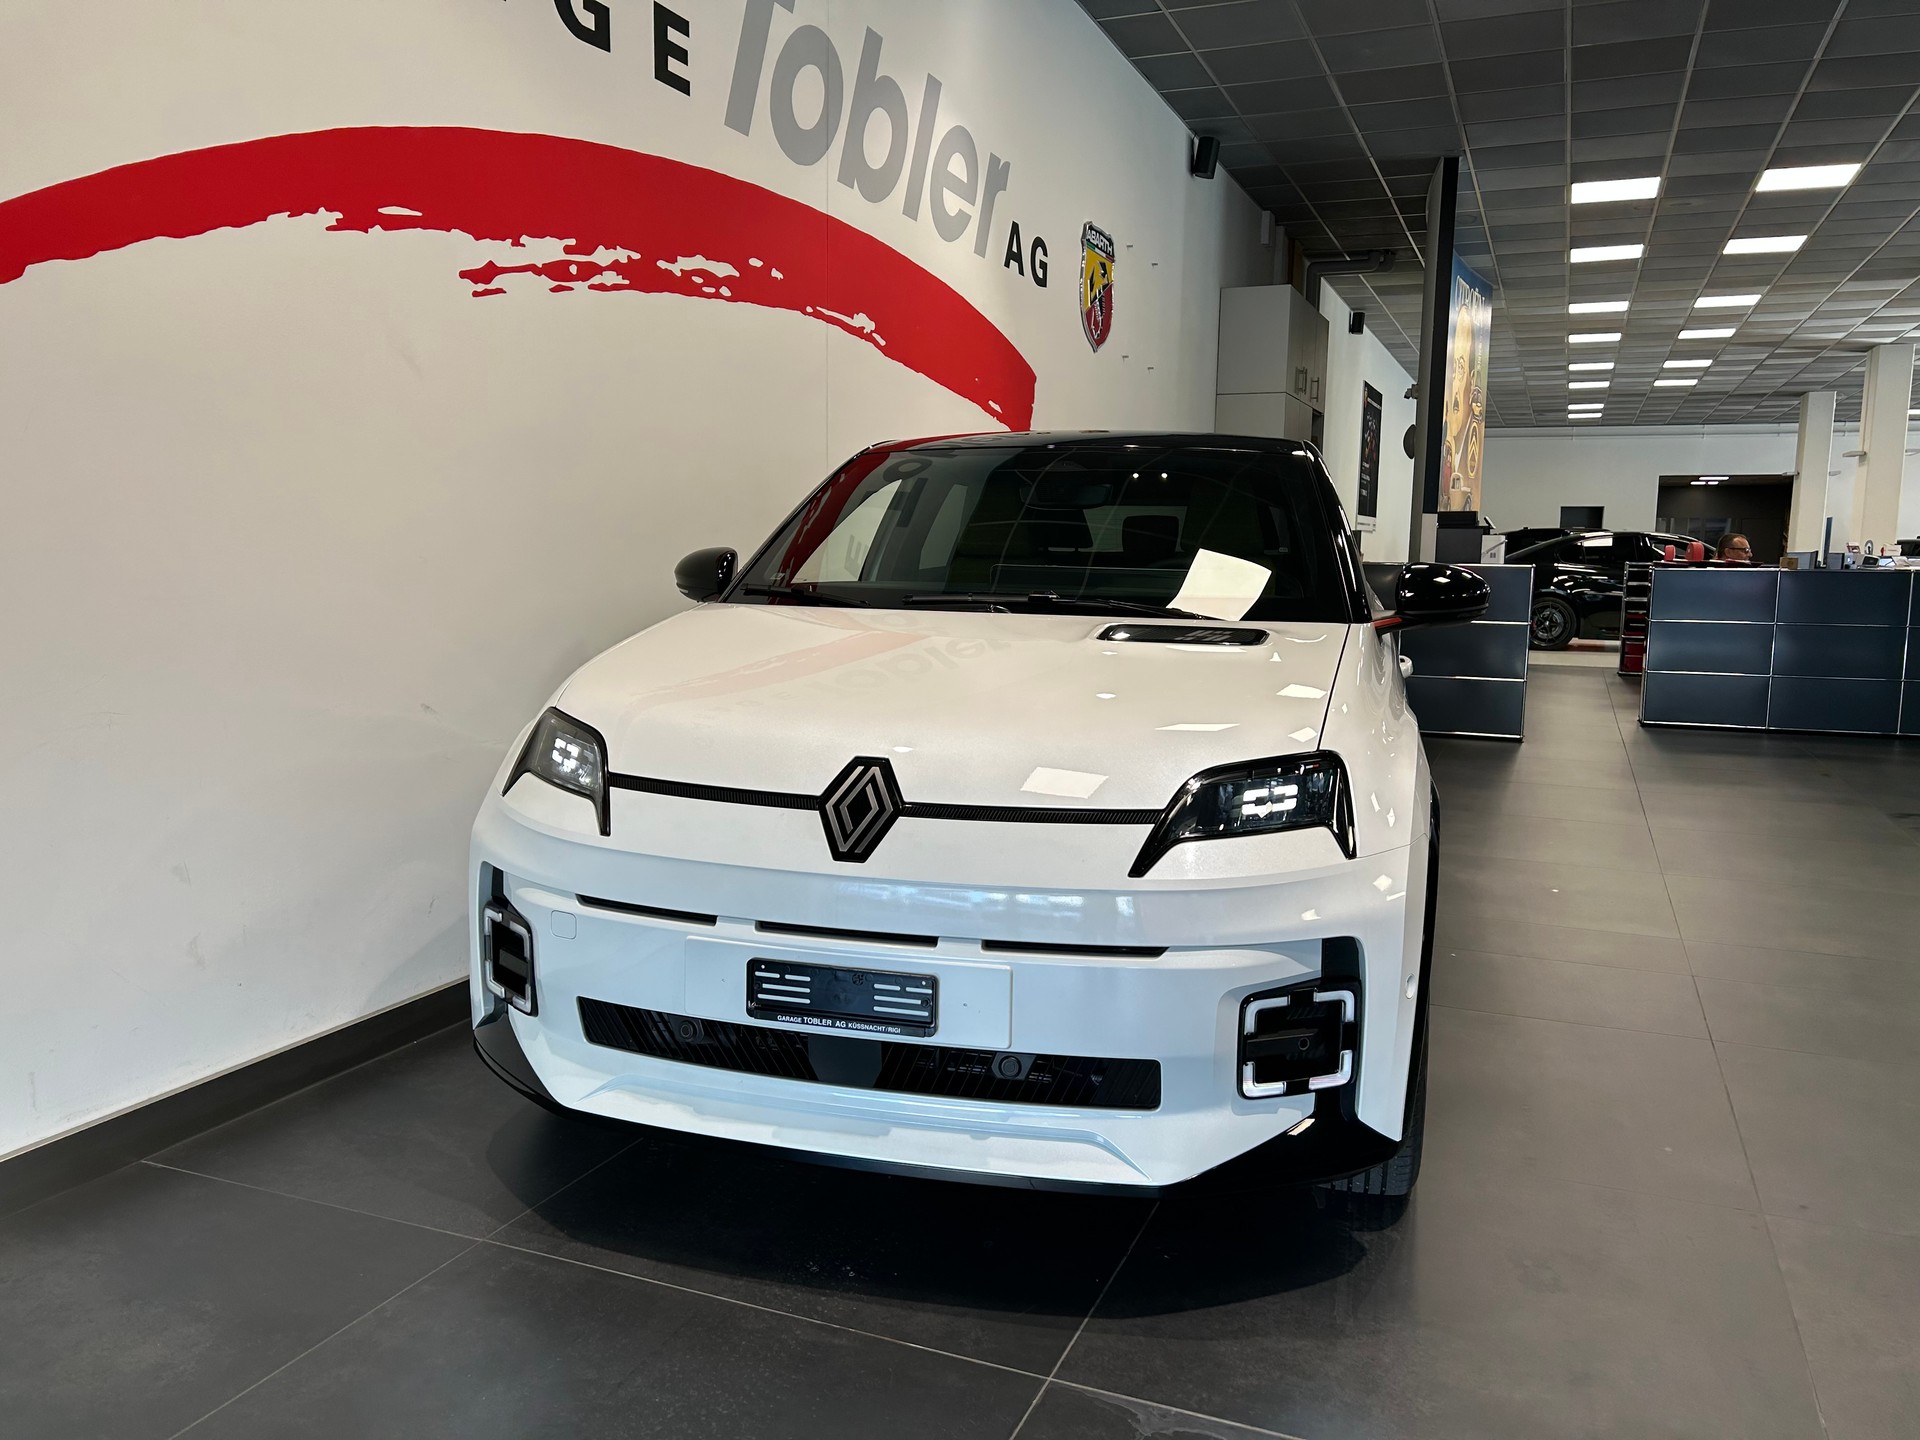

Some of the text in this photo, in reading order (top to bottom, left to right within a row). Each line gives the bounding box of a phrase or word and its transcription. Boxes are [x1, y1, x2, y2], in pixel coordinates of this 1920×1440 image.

[1002, 220, 1049, 289] AG
[1086, 229, 1113, 256] ABARTH
[777, 1014, 901, 1034] GARAGE TOBLER AG KÜSSNACHT/RIGI
